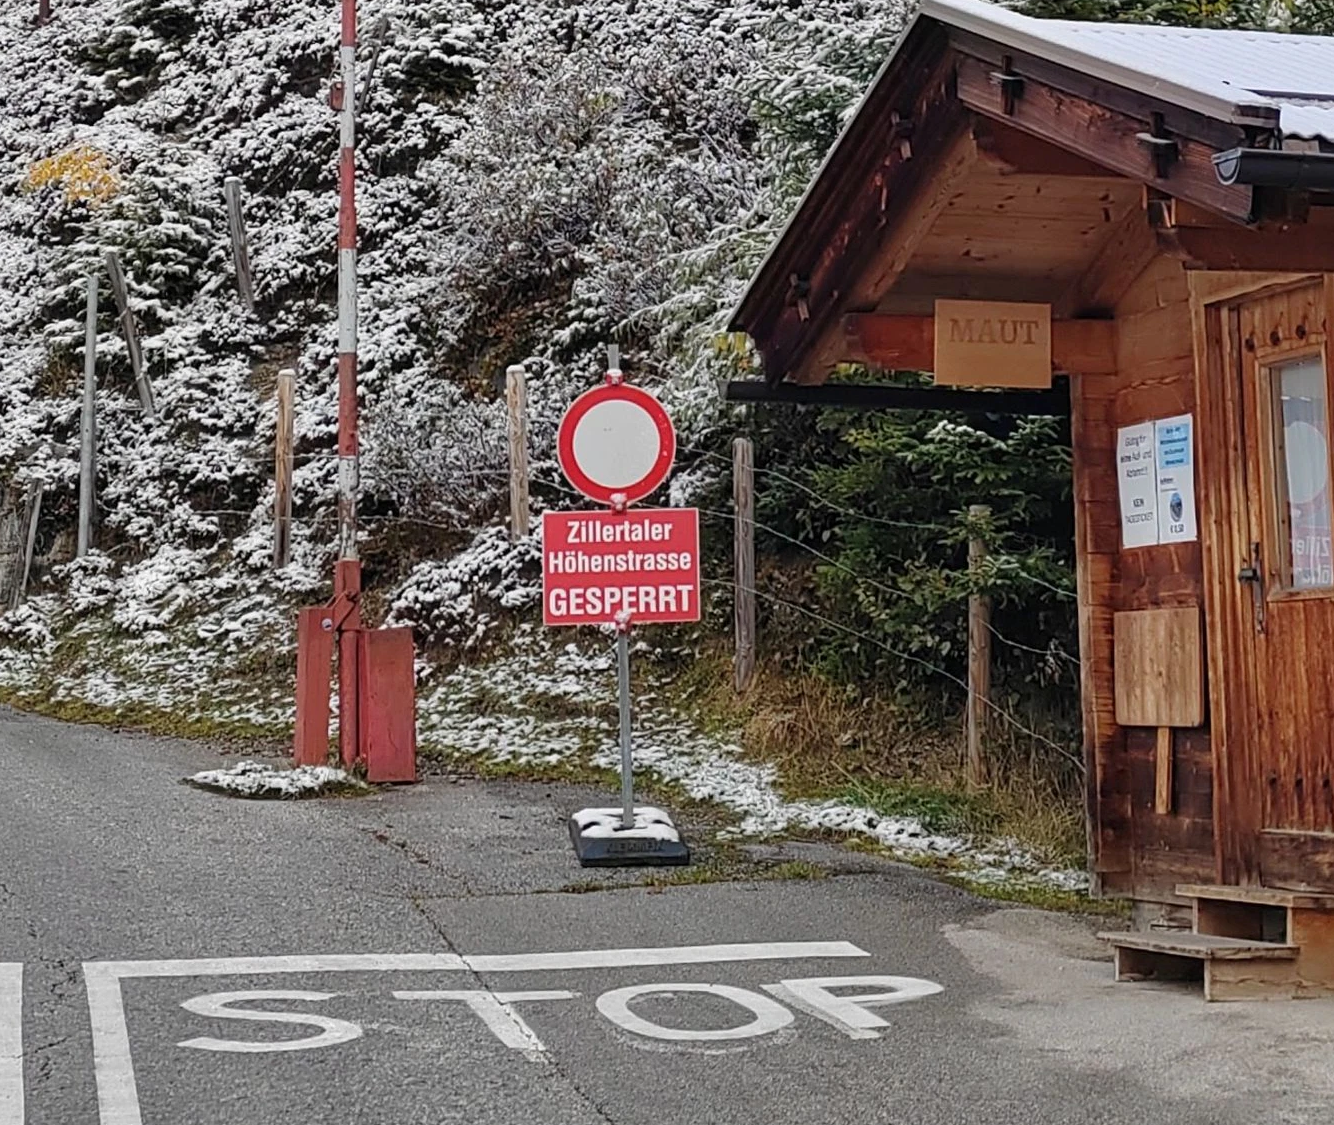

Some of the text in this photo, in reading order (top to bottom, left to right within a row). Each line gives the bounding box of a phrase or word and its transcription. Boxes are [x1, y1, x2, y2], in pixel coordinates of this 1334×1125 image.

[949, 318, 1039, 345] MAUT
[567, 520, 673, 544] Zillertaler
[548, 550, 692, 574] Höhenstrasse
[548, 584, 694, 616] GESPERRT
[175, 975, 945, 1062] STOP
